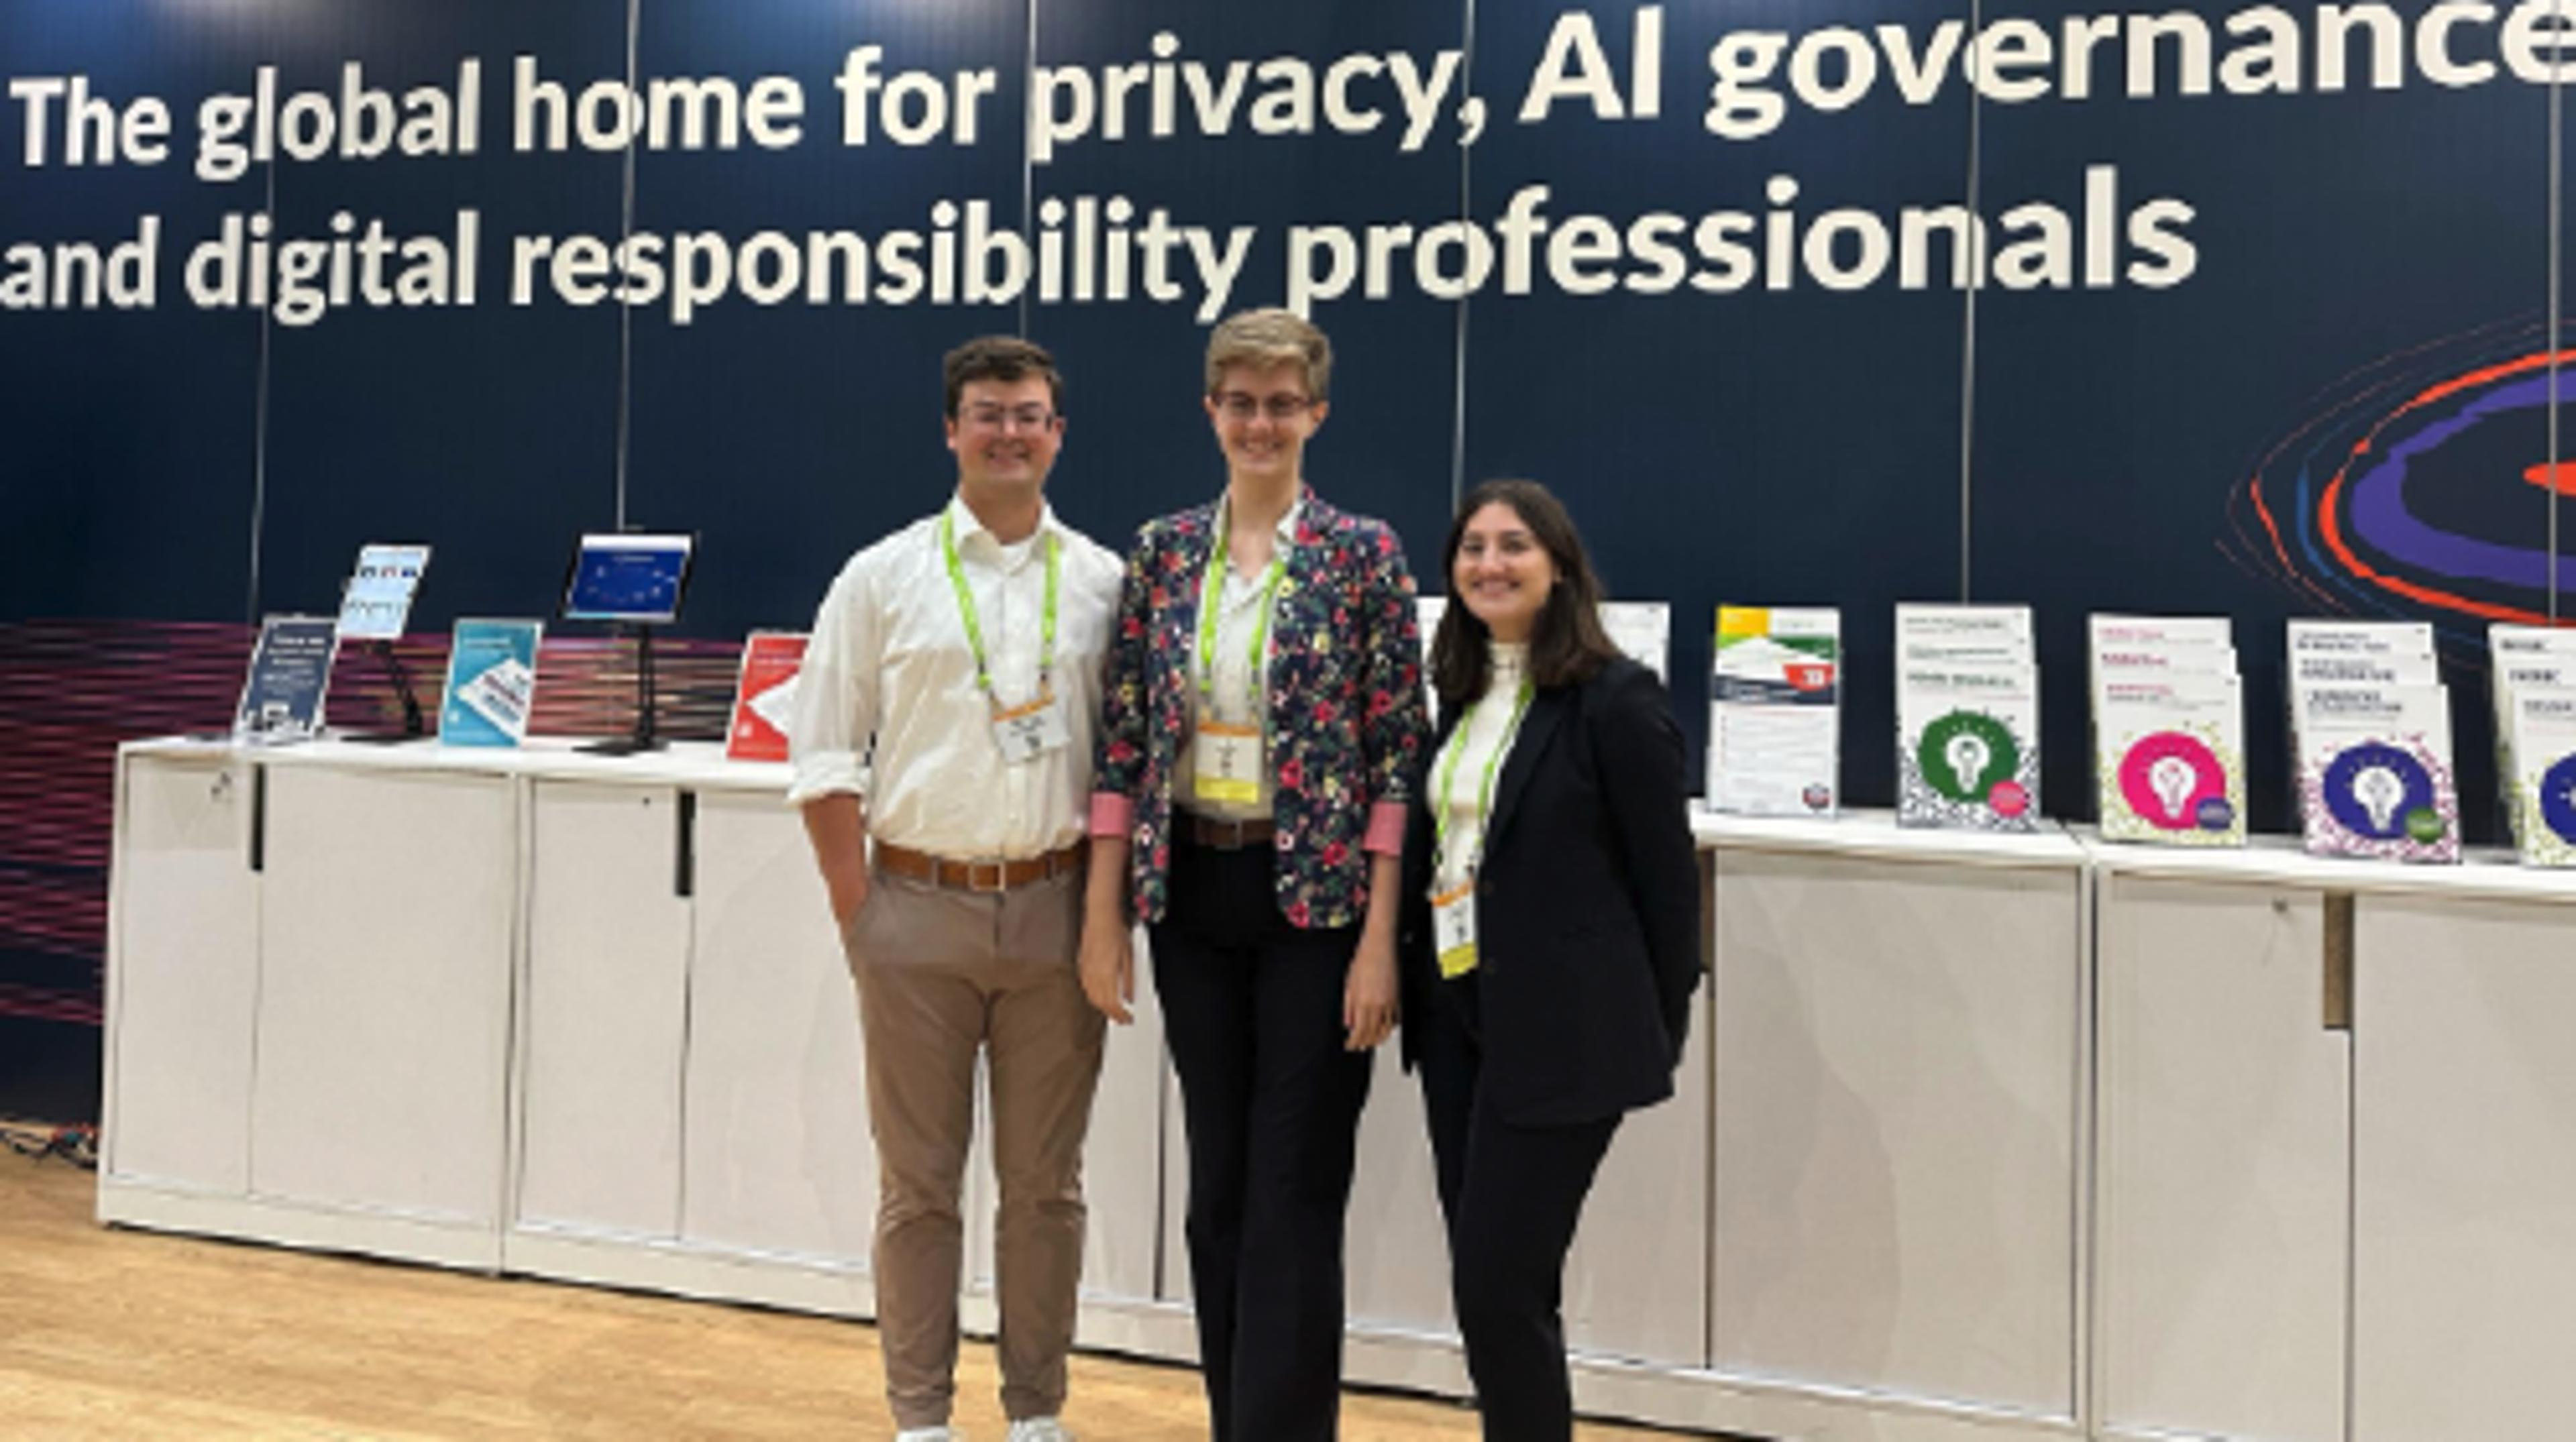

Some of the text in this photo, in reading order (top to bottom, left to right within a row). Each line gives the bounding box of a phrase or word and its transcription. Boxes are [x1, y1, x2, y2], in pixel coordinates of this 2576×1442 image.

[9, 0, 2576, 181] The global home for privacy, AI governance
[0, 165, 2198, 325] and digital responsibility professionals
